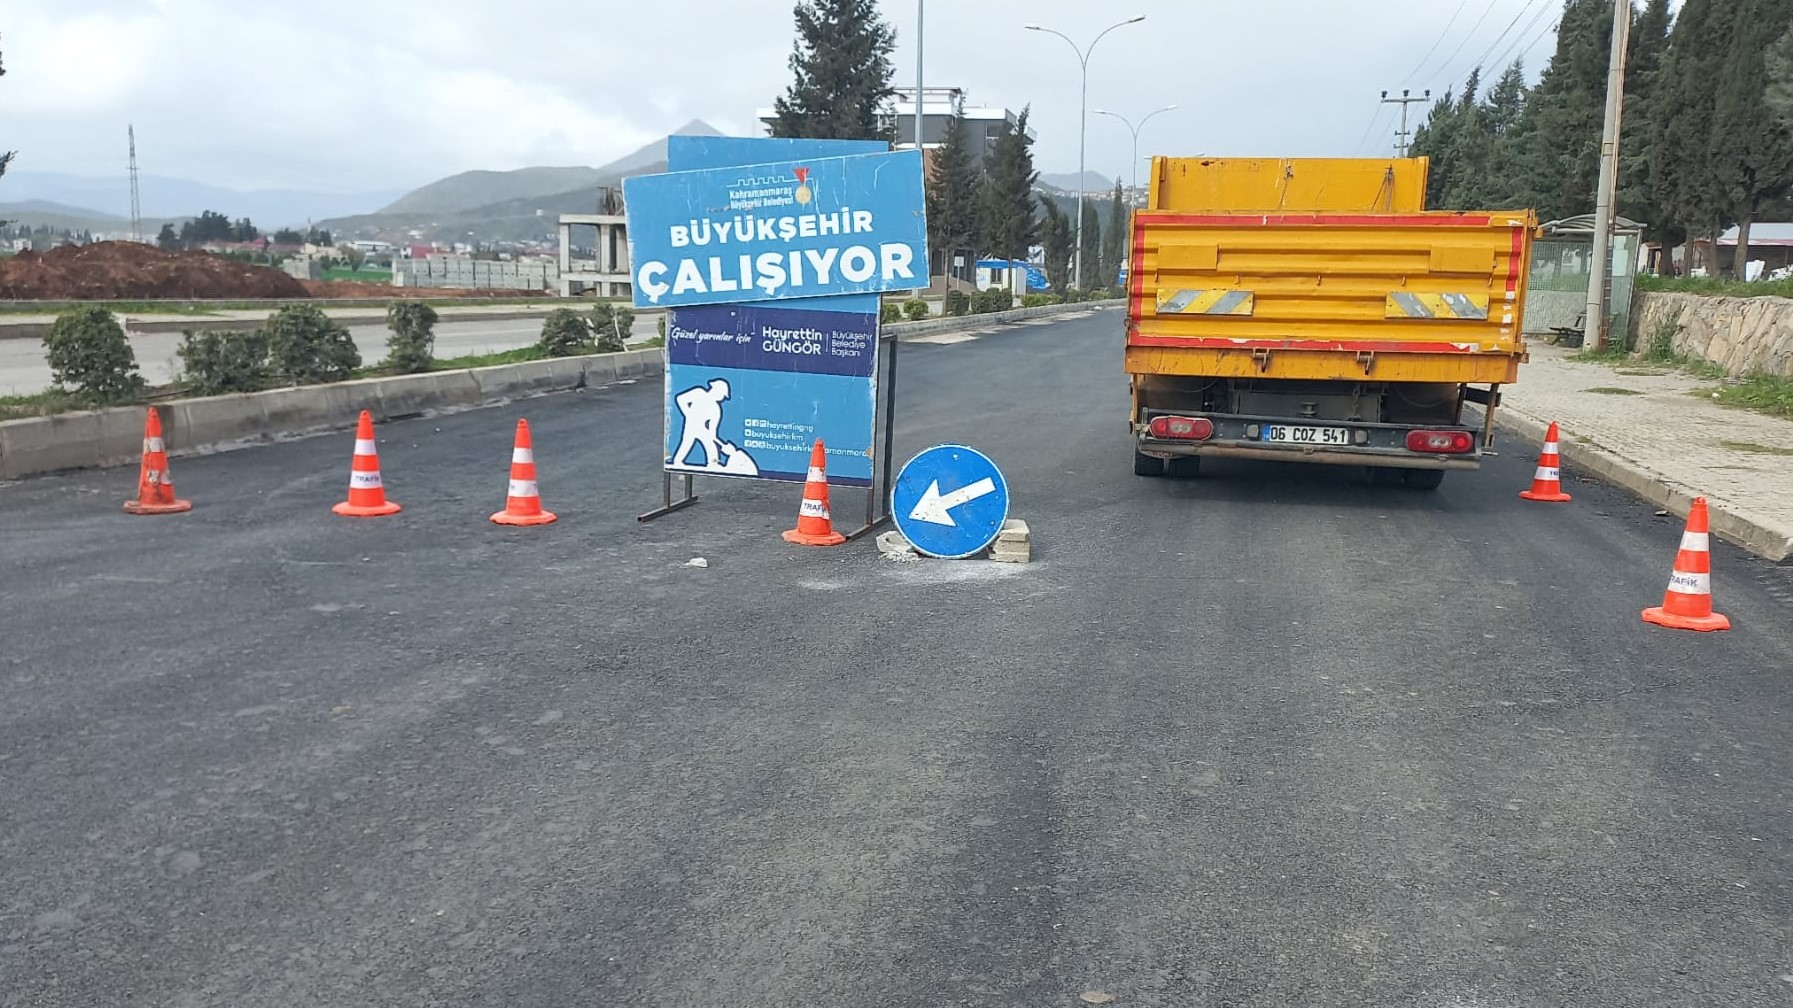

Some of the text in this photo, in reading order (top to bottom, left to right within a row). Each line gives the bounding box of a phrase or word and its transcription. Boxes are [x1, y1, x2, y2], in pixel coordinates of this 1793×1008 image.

[670, 207, 874, 248] BÜYÜKŞEHİR
[637, 242, 914, 304] ÇALIŞIYOR
[762, 326, 823, 341] Hayrettin
[832, 330, 873, 342] Büyükşehir
[762, 339, 822, 355] GÜNGÖR
[831, 339, 866, 350] Belediye
[1270, 427, 1285, 440] 06
[1293, 428, 1316, 442] COZ
[1323, 429, 1346, 443] 541
